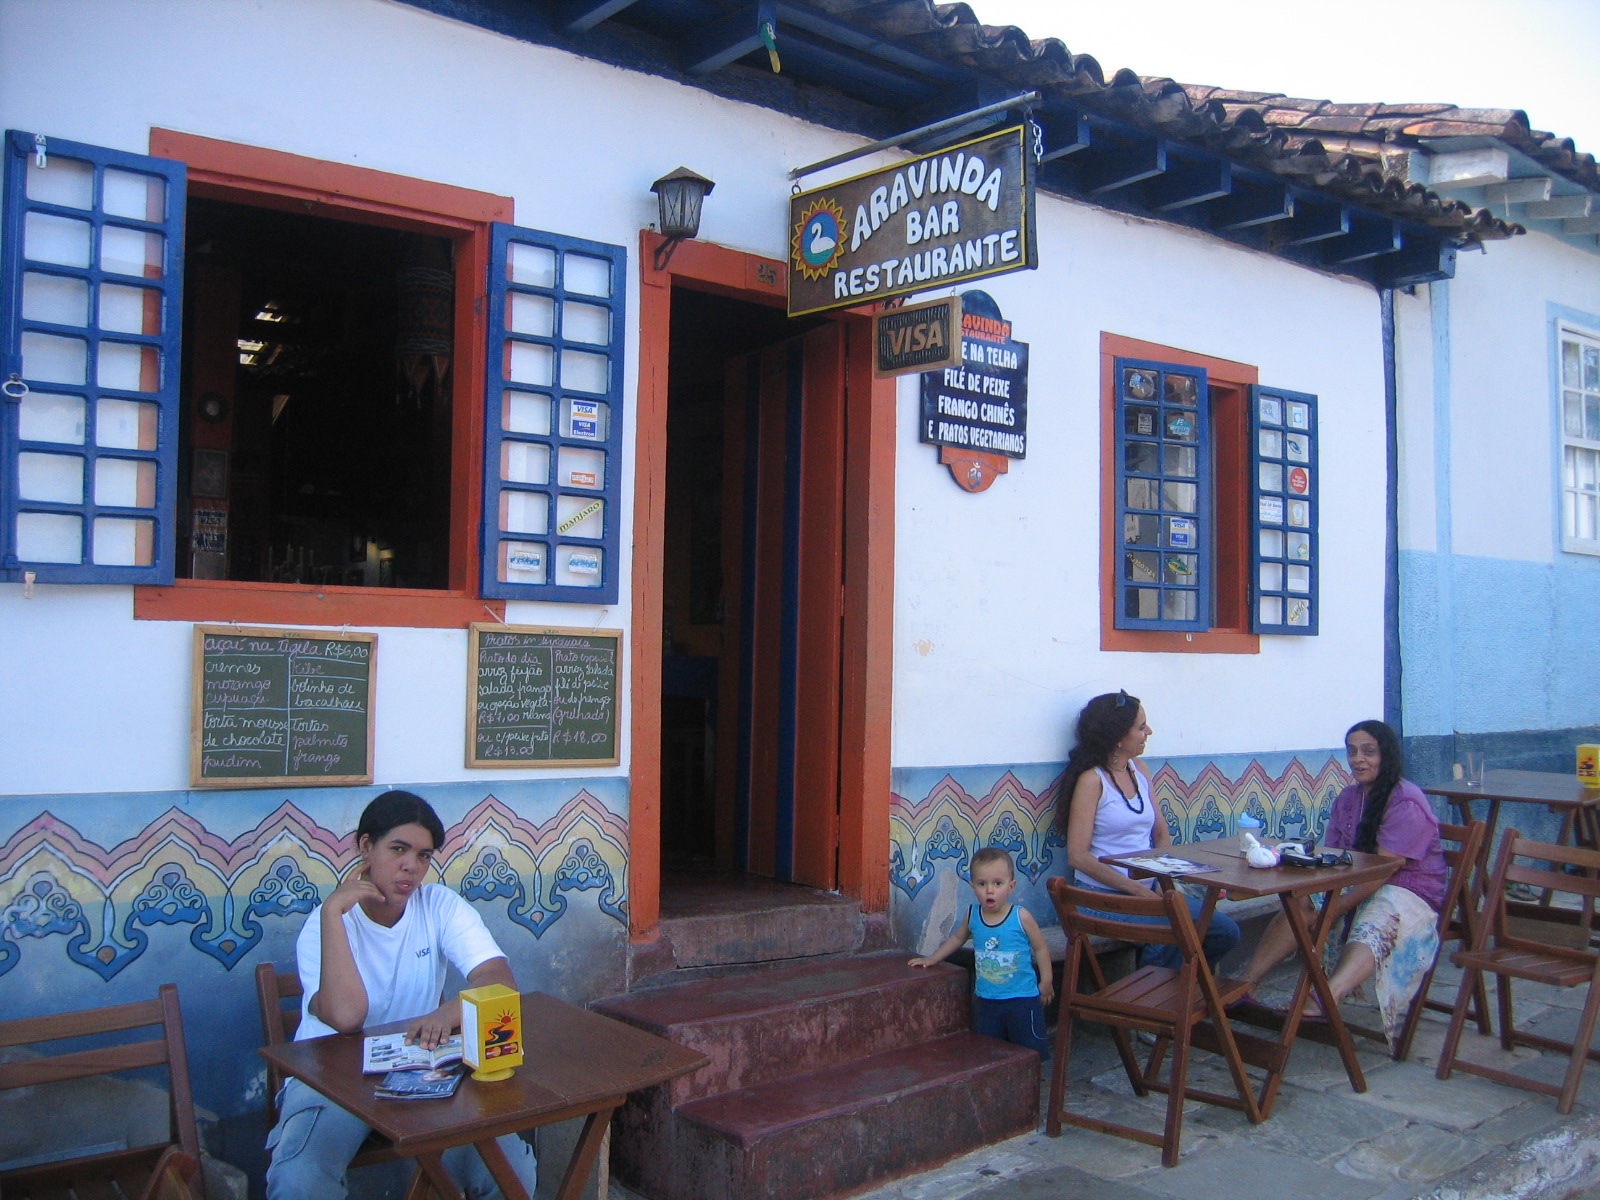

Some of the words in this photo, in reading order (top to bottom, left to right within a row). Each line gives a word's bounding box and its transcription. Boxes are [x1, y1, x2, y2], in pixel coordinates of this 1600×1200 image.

[851, 153, 1002, 252] ARAVINDA
[906, 200, 960, 245] BAR
[757, 262, 777, 286] 25
[834, 230, 1018, 300] RESTAURANTE
[961, 313, 1010, 337] AVINDA
[886, 320, 944, 356] VISA
[970, 343, 984, 363] NA
[987, 346, 1018, 370] TELHA
[944, 366, 965, 390] FILÉ
[968, 373, 981, 393] DE
[983, 375, 1010, 399] PEIXE
[577, 406, 593, 414] VISA
[938, 395, 978, 420] FRANGO
[981, 402, 1015, 427] CHINÊS
[573, 429, 595, 437] Electron
[928, 420, 934, 439] E
[938, 421, 968, 445] PRATOS
[970, 426, 1024, 454] VEGETARIANOS
[250, 640, 274, 652] na
[205, 661, 261, 674] cremes
[520, 652, 542, 665] dia
[478, 666, 507, 685] arroz
[556, 664, 584, 682] arroz
[205, 679, 271, 695] morango
[292, 679, 334, 694] bolinho
[338, 682, 355, 694] de
[478, 682, 515, 696] salada
[517, 682, 551, 701] frango
[295, 695, 364, 711] bacalhau
[554, 697, 568, 705] ou
[204, 712, 237, 729] torta
[204, 733, 218, 747] de
[223, 731, 286, 746] chocolate
[293, 733, 348, 749] palmito
[477, 734, 493, 743] ou
[203, 754, 261, 775] pudim
[293, 749, 341, 771] frango
